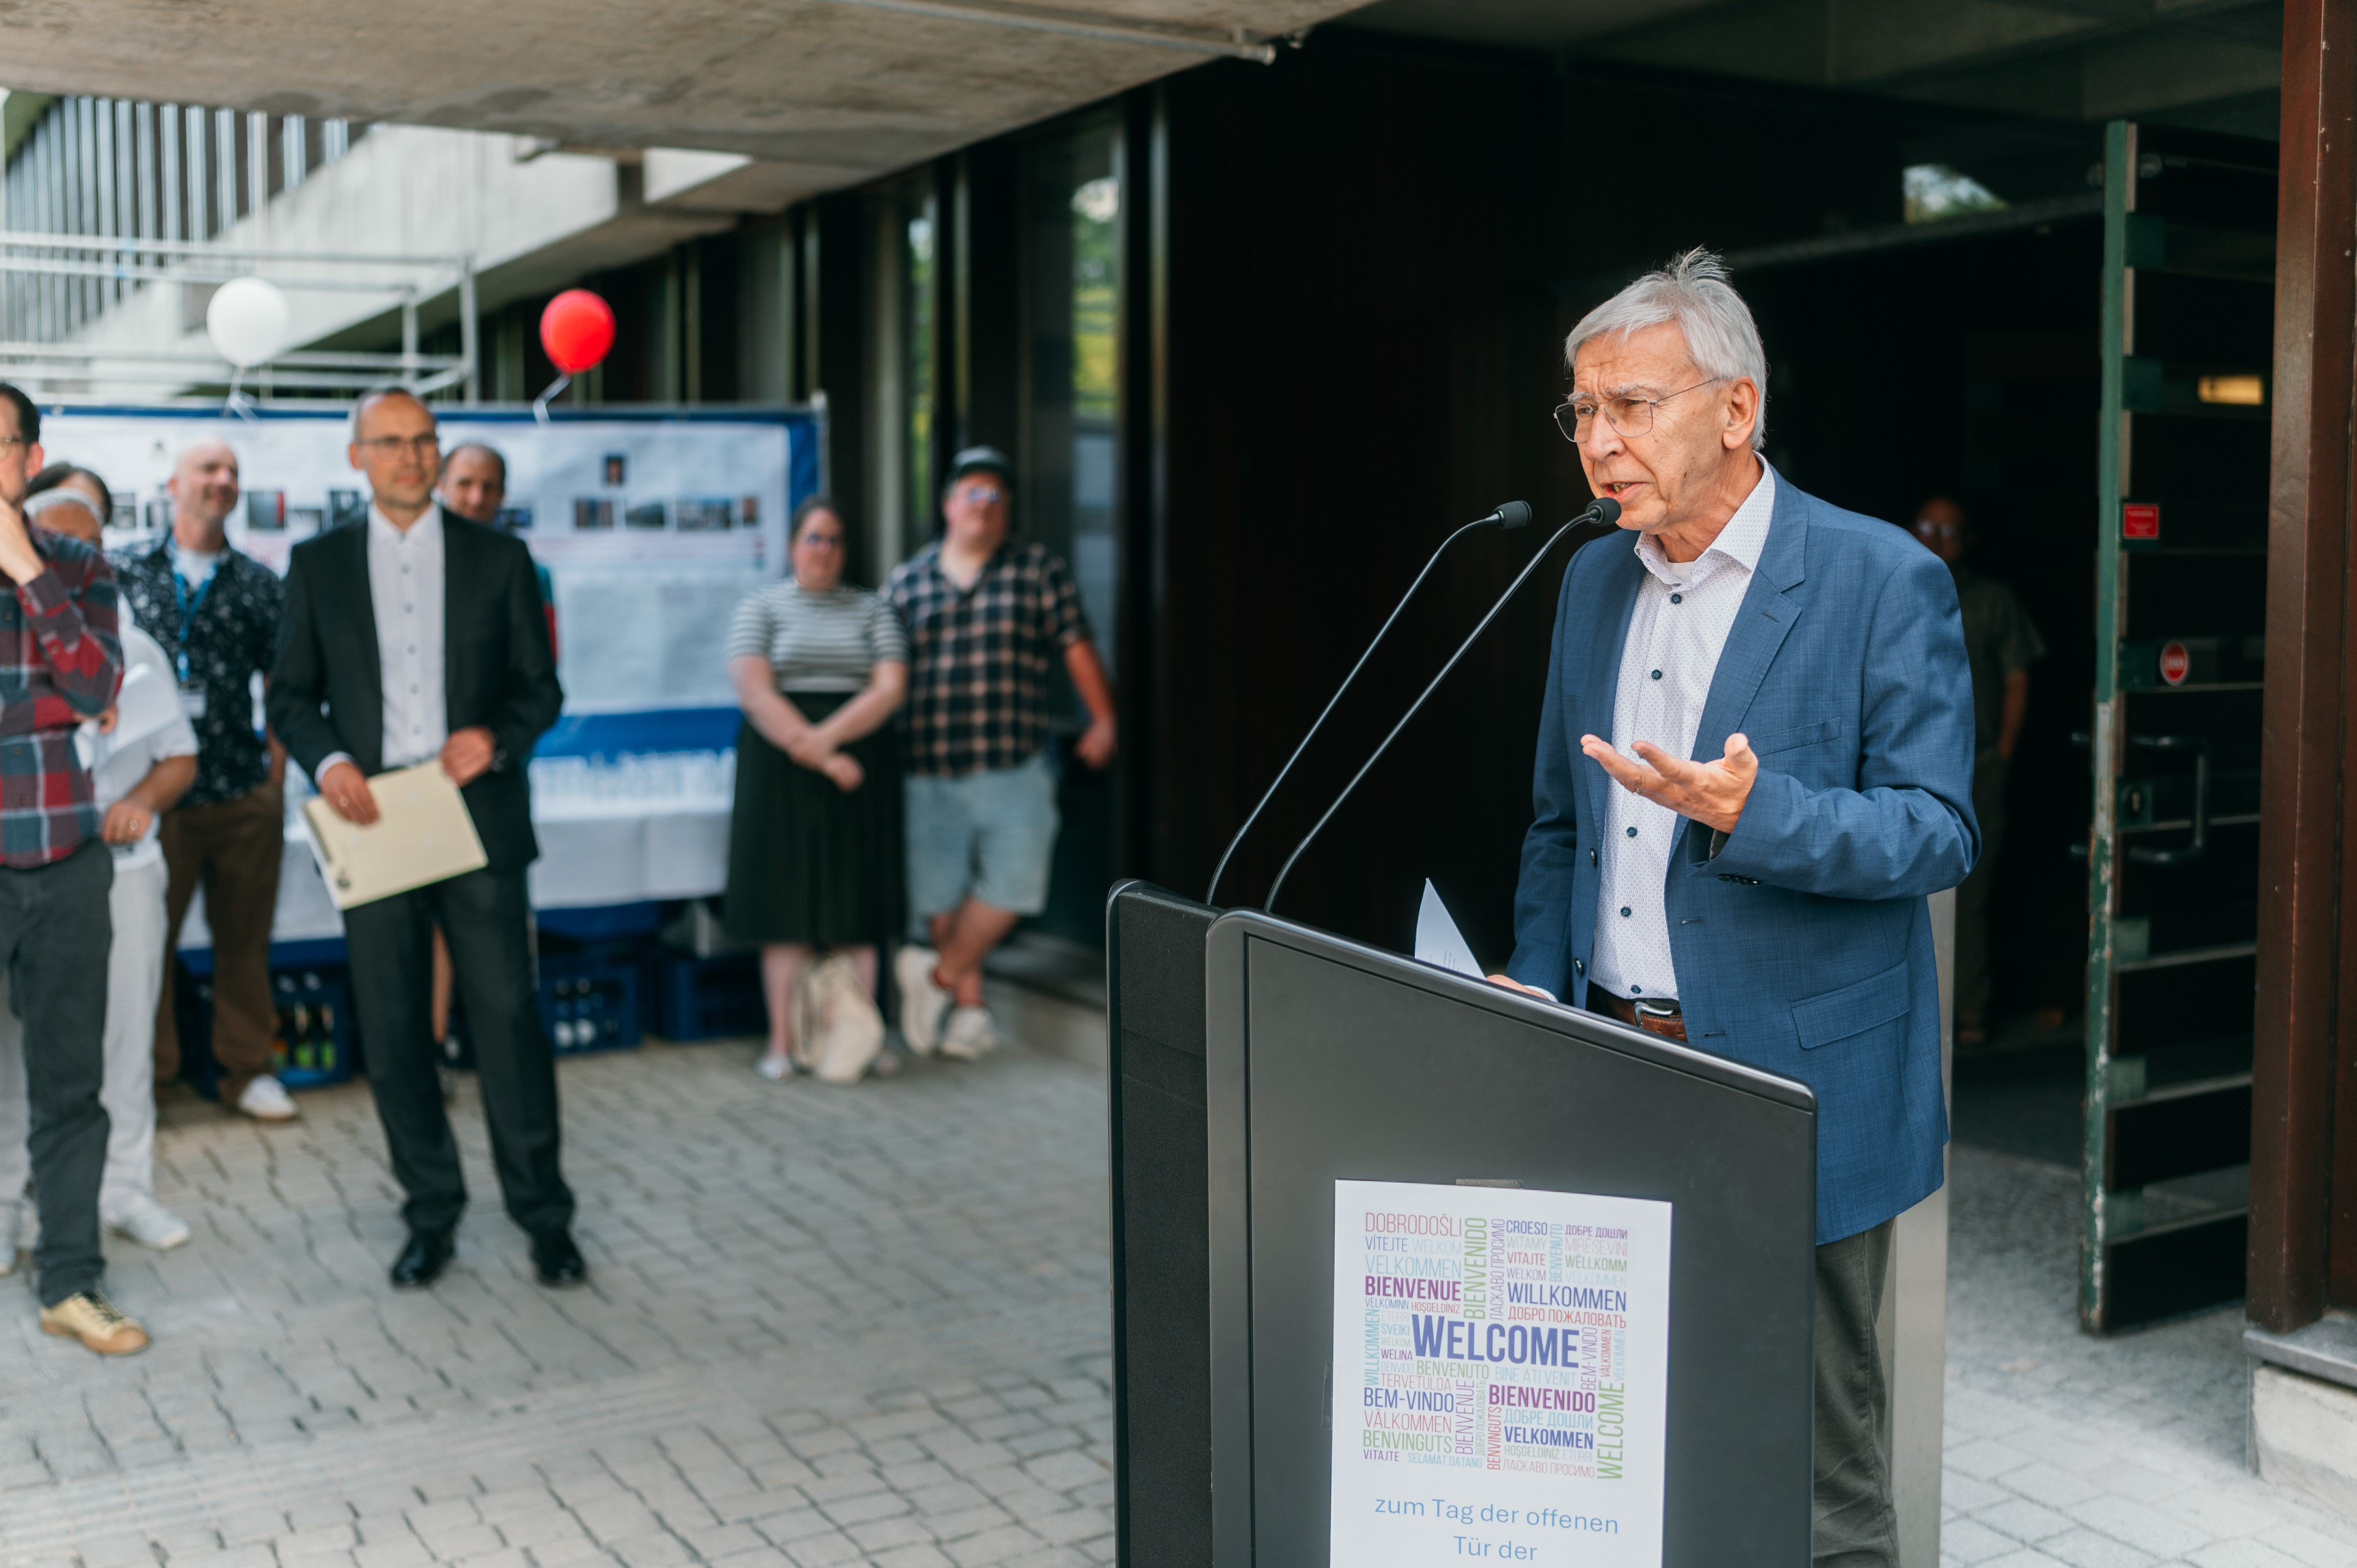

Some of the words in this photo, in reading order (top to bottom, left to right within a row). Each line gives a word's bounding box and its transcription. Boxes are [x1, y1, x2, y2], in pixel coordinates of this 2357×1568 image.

[1366, 1213, 1461, 1237] DOBRODOŠLI
[1506, 1220, 1548, 1235] CROESO
[1565, 1224, 1593, 1237] ДОБРЕ
[1595, 1227, 1628, 1240] ДОШЛИ
[1365, 1234, 1408, 1252] VÍTEJTE
[1412, 1239, 1461, 1255] WELKOM
[1491, 1219, 1505, 1268] ПРОСИМО
[1506, 1236, 1547, 1250] WITAMY
[1549, 1224, 1563, 1283] BENVENUTO
[1565, 1237, 1627, 1257] MIRËSEVINI
[1365, 1254, 1461, 1279] VELKOMMEN
[1464, 1218, 1487, 1319] BIENVENIDO
[1507, 1251, 1546, 1266] VITAJTE
[1565, 1254, 1626, 1272] WËLLKOMM
[1506, 1267, 1546, 1281] WELKOM
[1565, 1270, 1626, 1288] VELKOMMEN
[1365, 1275, 1461, 1301] BIENVENUE
[1490, 1271, 1504, 1322] ЛАСКАВО
[1507, 1281, 1626, 1312] WILLKOMMEN
[1365, 1297, 1409, 1309] VELKOMINN
[1381, 1311, 1409, 1323] ETORRI
[1508, 1306, 1545, 1321] ДОБРО
[1548, 1309, 1626, 1328] ПОЖАЛОВАТЬ
[1381, 1323, 1410, 1336] SVEIKI
[1412, 1314, 1579, 1368] WELCOME
[1364, 1309, 1380, 1386] WILLKOMMEN
[1381, 1337, 1410, 1347] WELKOM
[1599, 1329, 1611, 1377] VÄLKOMMEN
[1381, 1348, 1413, 1361] WELINA
[1581, 1327, 1597, 1390] BEM-VINDO
[1613, 1330, 1625, 1381] VELKOMMEN
[1381, 1362, 1414, 1374] BENVIDO
[1417, 1360, 1489, 1379] BENVENUTO
[1495, 1366, 1519, 1382] BINE
[1523, 1369, 1540, 1383] ATI
[1544, 1370, 1577, 1386] VENIT
[1380, 1373, 1451, 1392] TERVETULOA
[1364, 1387, 1454, 1413] BEM-VINDO
[1476, 1380, 1486, 1430] ПОЖАЛОВАТЬ
[1489, 1384, 1595, 1413] BIENVENIDO
[1364, 1409, 1451, 1433] VÄLKOMMEN
[1455, 1379, 1474, 1455] BIENVENUE
[1504, 1408, 1543, 1425] ДОБРЕ
[1547, 1412, 1593, 1430] ДОШЛИ
[1363, 1429, 1452, 1453] BENVINGUTS
[1487, 1406, 1501, 1470] BENVINGUTS
[1504, 1426, 1593, 1450] VELKOMMEN
[1597, 1381, 1624, 1479] WELCOME
[1364, 1449, 1400, 1462] VITAJTE
[1475, 1432, 1485, 1456] ДОБРО
[1408, 1453, 1447, 1465] SELAMAT
[1449, 1455, 1482, 1468] DATANG
[1563, 1449, 1592, 1463] ETORRI
[1502, 1458, 1548, 1473] ЛАСКАВО
[1550, 1463, 1594, 1478] ПРОСИМО
[1375, 1499, 1424, 1516] zum
[1432, 1499, 1474, 1525] Tag
[1480, 1504, 1519, 1524] der
[1526, 1508, 1618, 1534] offenen
[1454, 1536, 1491, 1557] Tür
[1499, 1541, 1538, 1561] der
